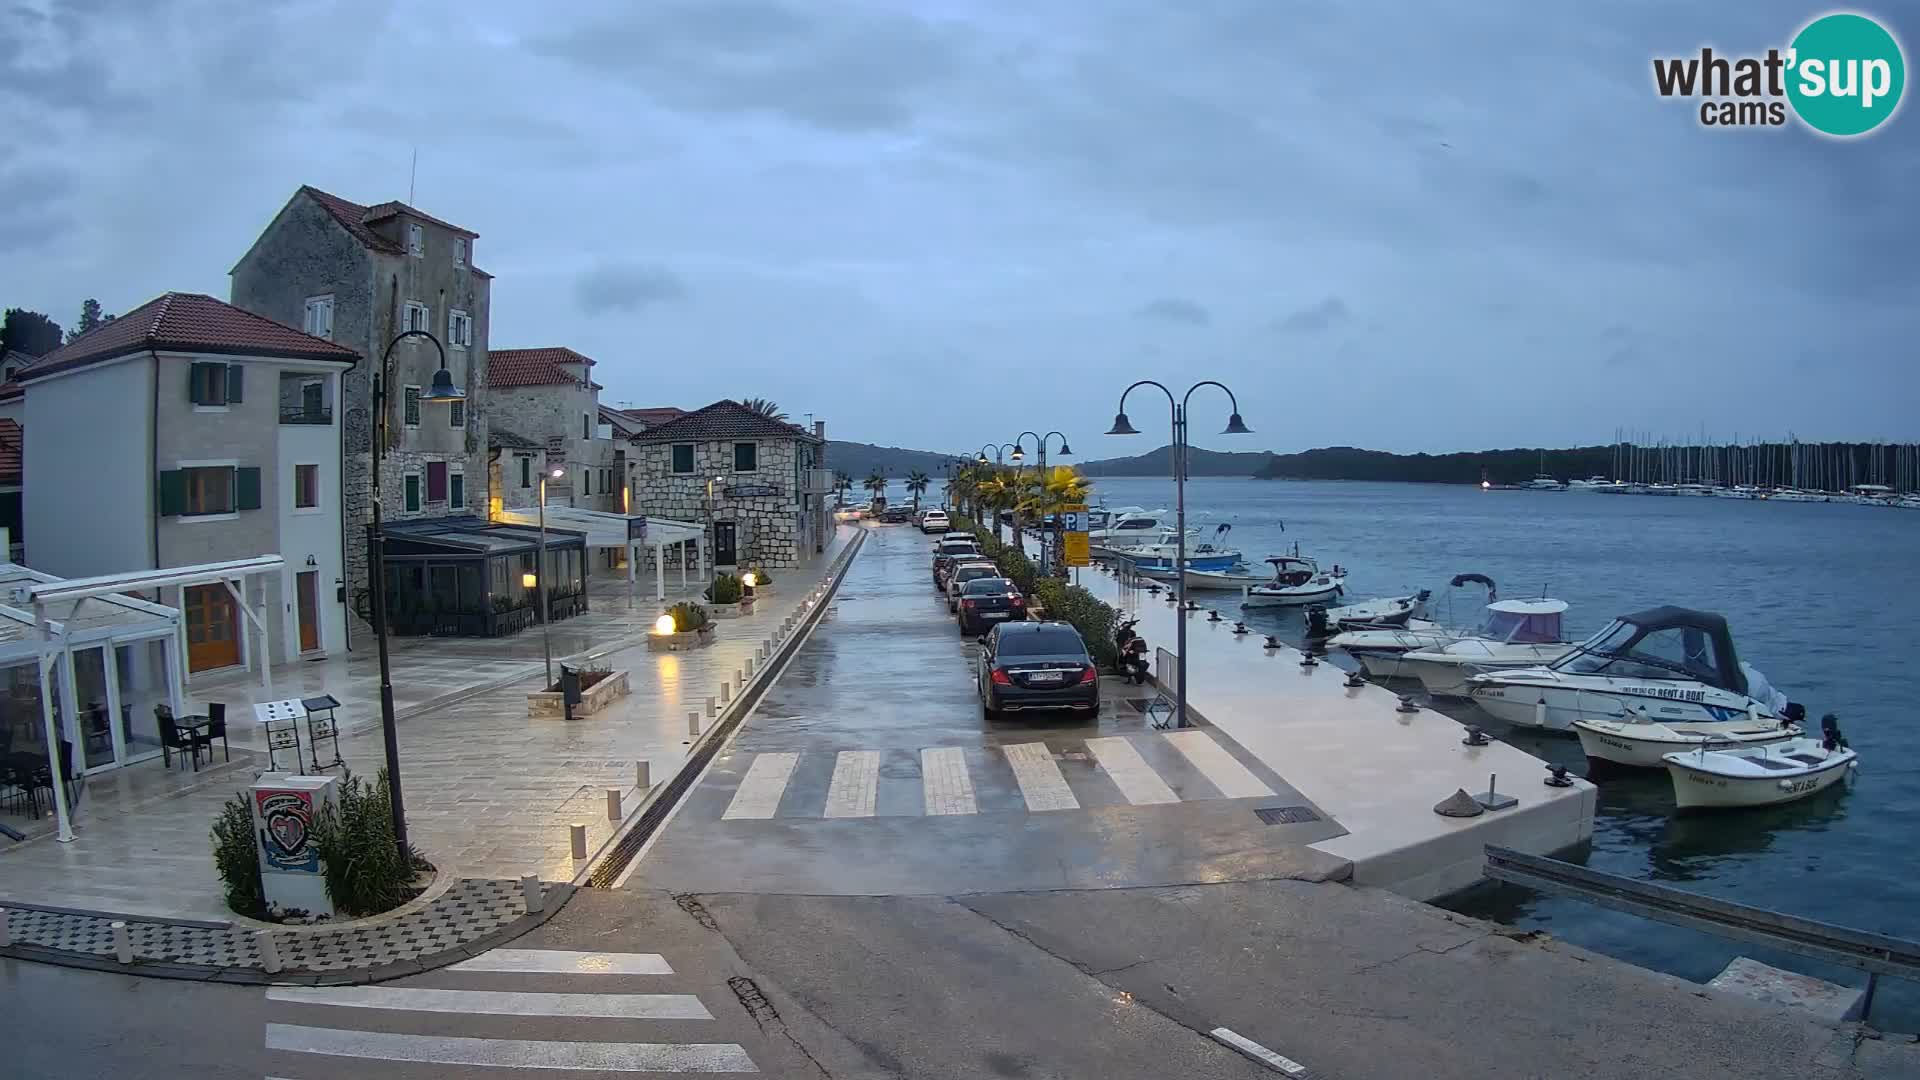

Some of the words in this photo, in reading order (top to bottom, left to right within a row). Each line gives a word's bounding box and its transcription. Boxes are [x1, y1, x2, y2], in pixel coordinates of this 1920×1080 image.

[1657, 687, 1679, 698] RENT
[1679, 689, 1685, 700] A
[1685, 690, 1706, 702] BOAT
